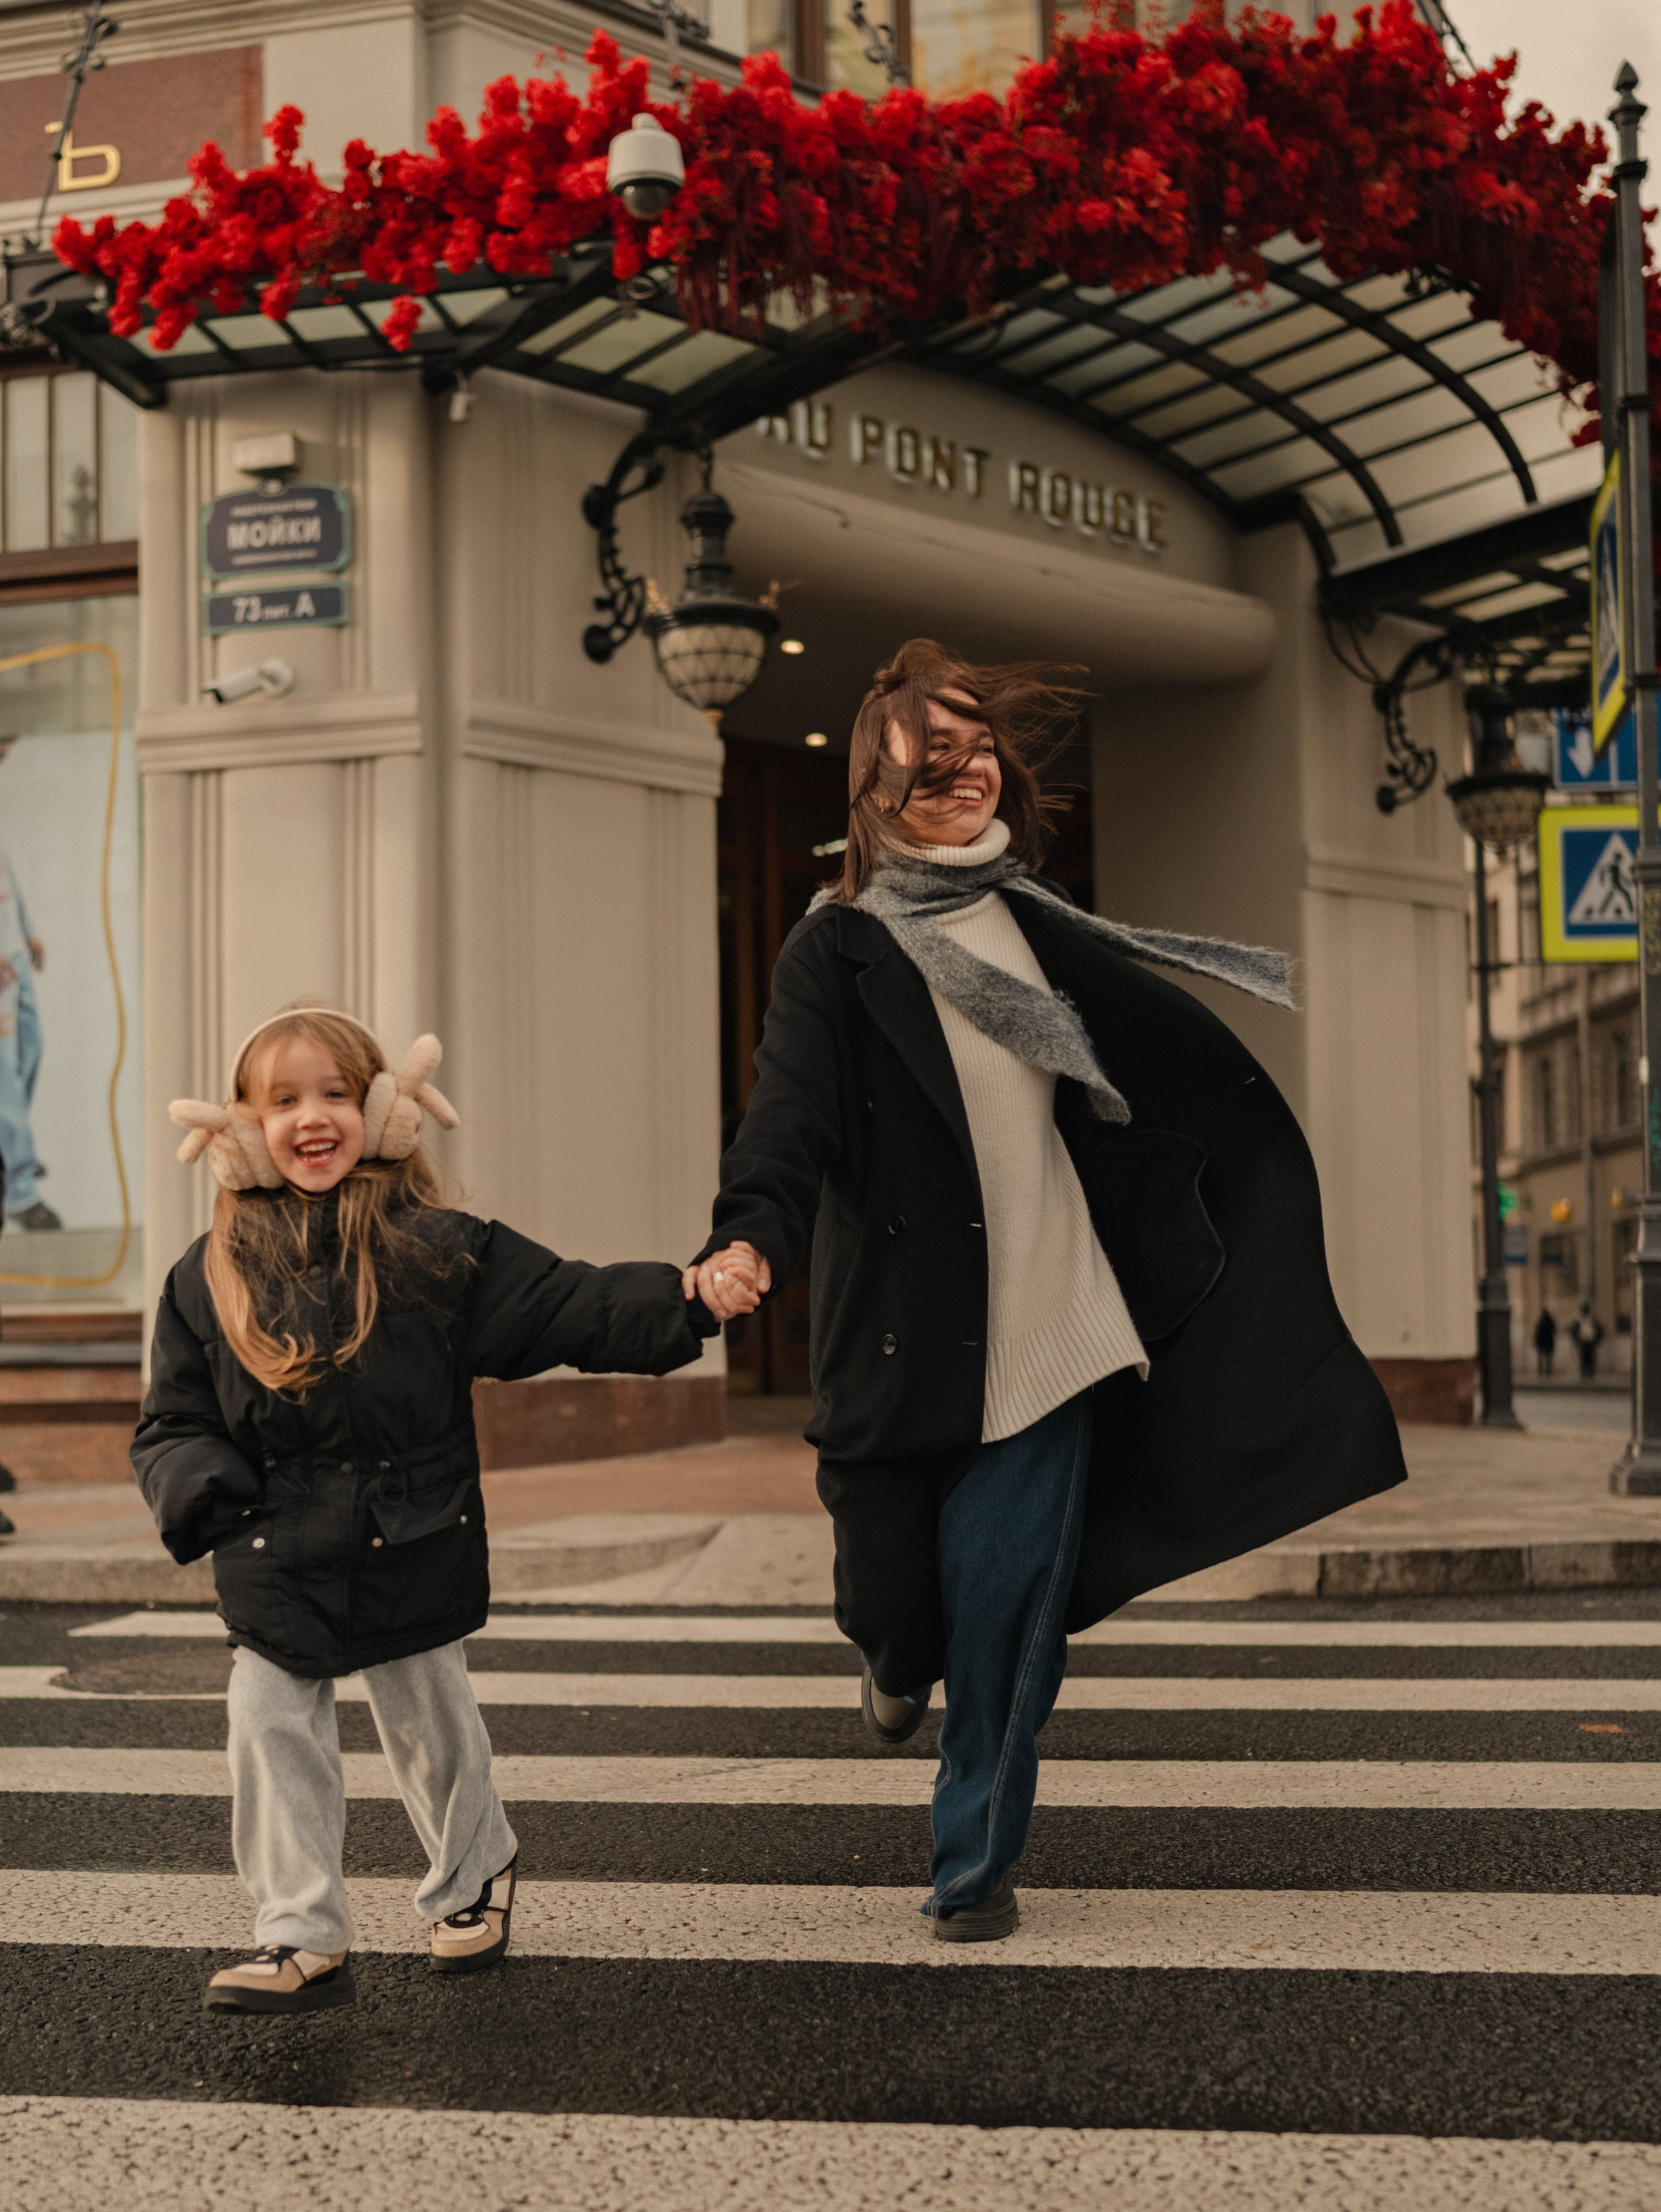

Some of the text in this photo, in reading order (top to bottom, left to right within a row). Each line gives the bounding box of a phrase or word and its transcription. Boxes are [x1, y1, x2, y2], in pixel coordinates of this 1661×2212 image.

[850, 412, 989, 498] PONT
[1008, 459, 1167, 552] ROUGE
[227, 515, 321, 550] МОЙКИ
[232, 595, 261, 623] 73
